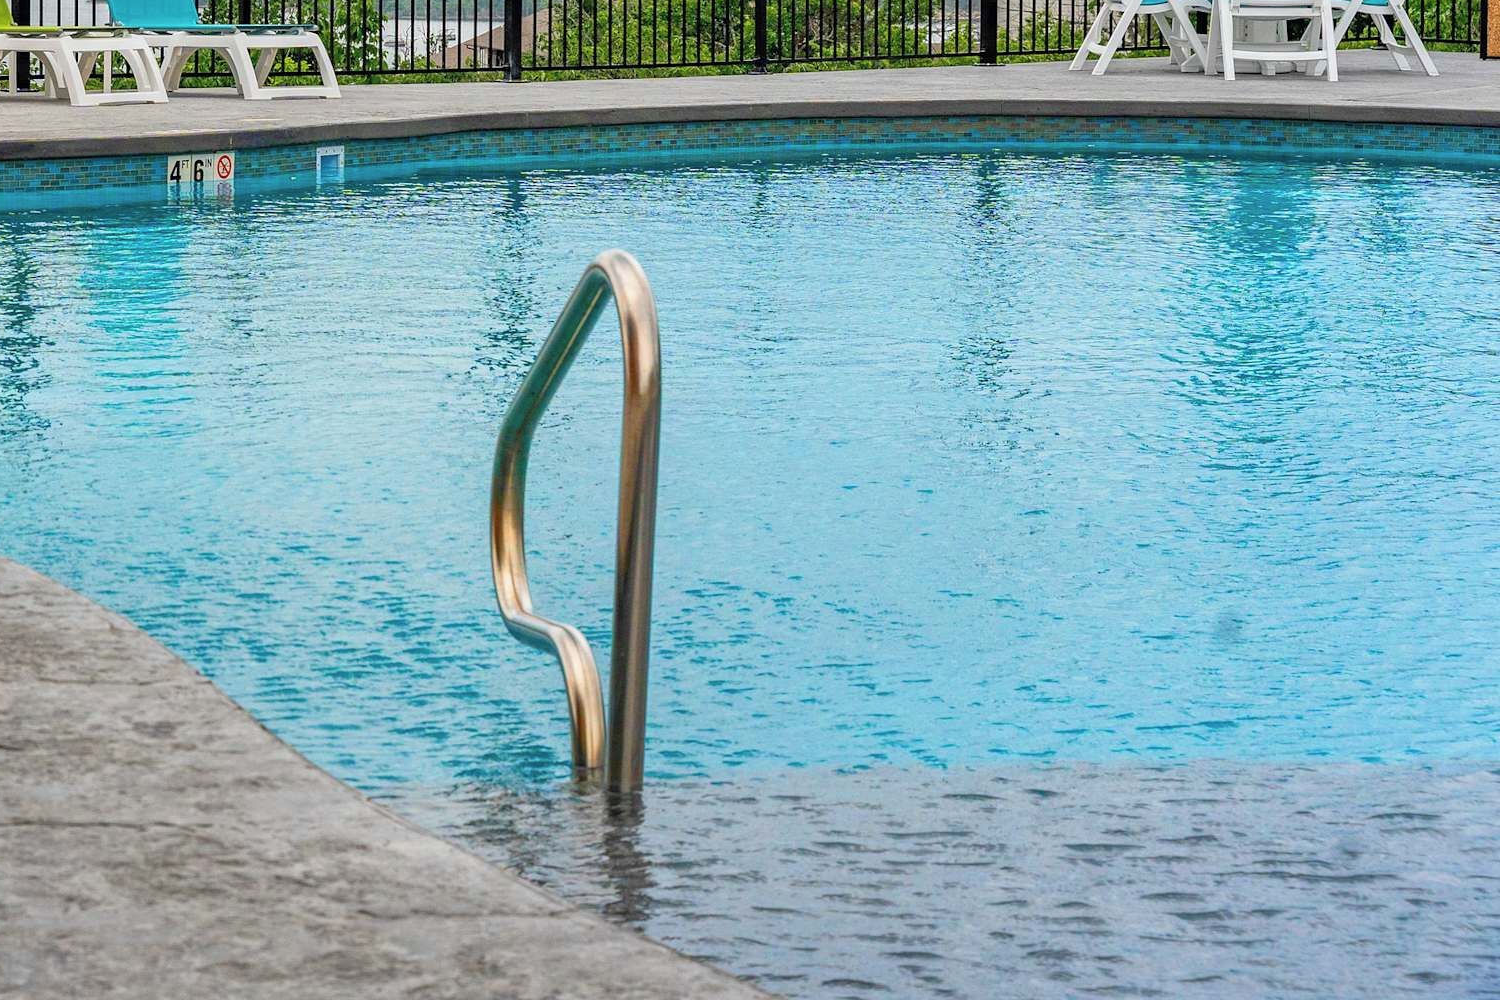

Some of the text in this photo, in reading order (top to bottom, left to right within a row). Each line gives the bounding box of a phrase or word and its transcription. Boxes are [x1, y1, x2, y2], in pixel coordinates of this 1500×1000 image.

[170, 160, 181, 183] 4
[182, 160, 189, 168] FT
[194, 160, 204, 182] 6
